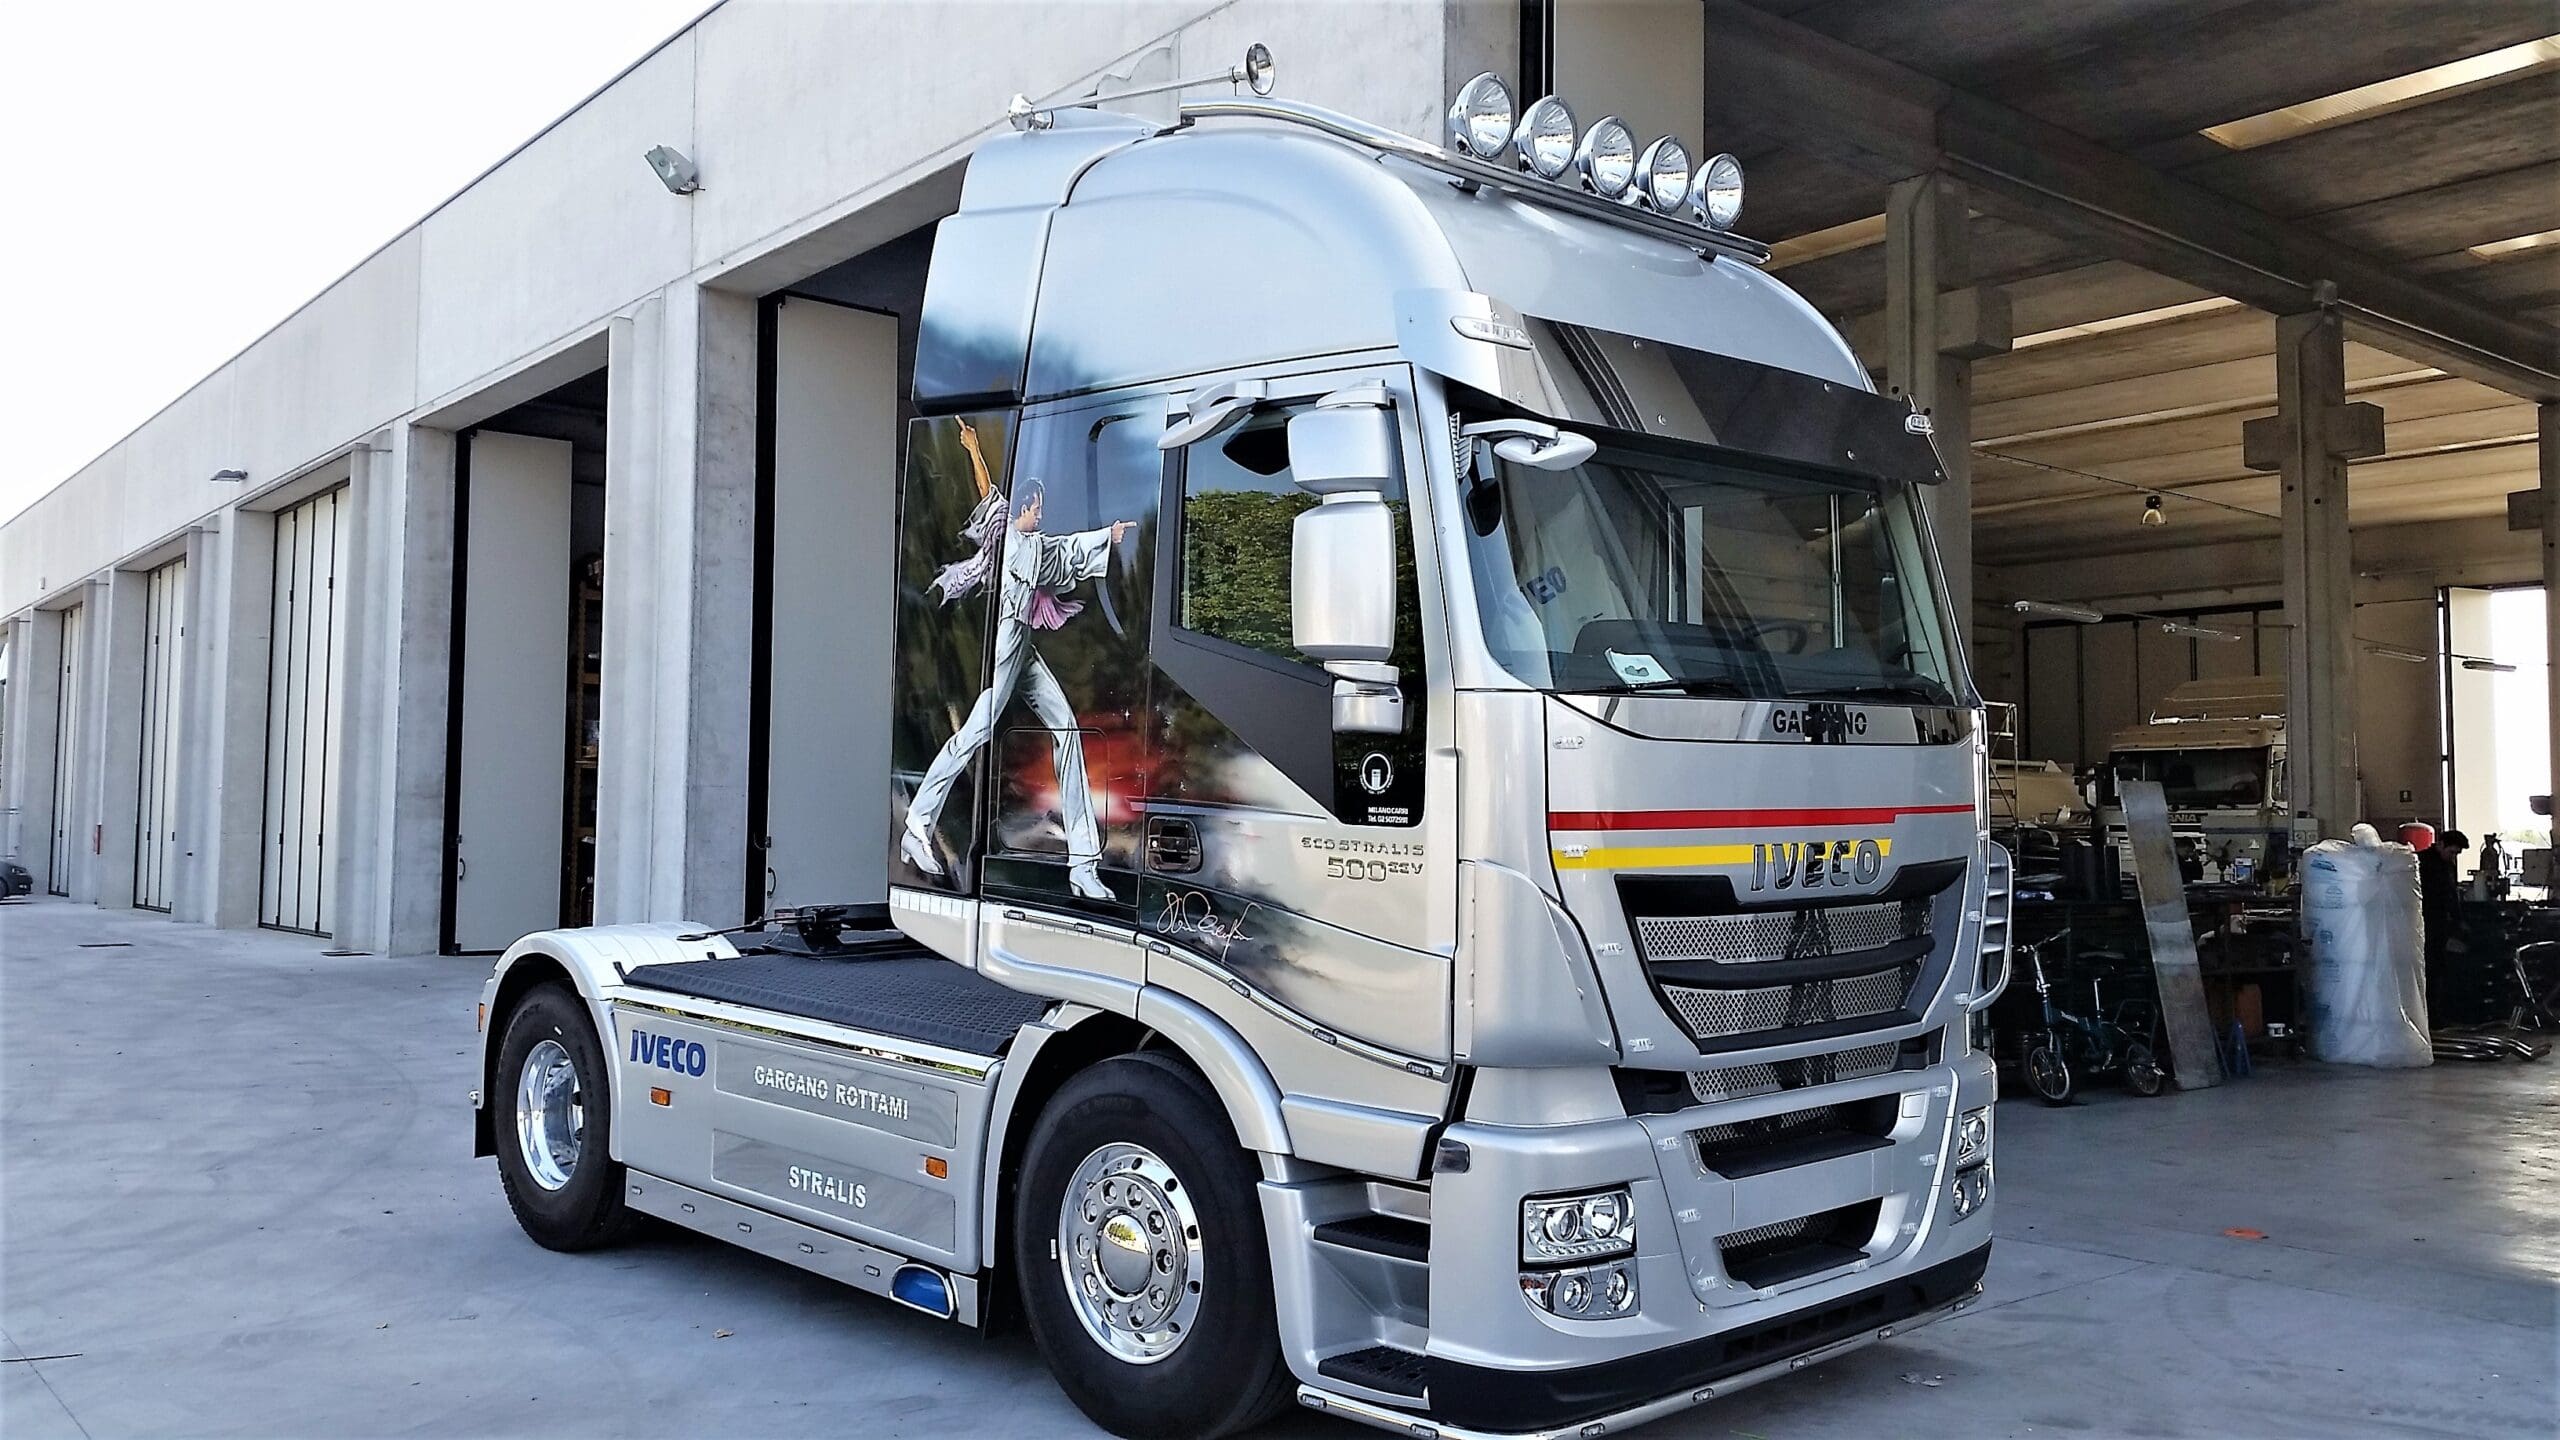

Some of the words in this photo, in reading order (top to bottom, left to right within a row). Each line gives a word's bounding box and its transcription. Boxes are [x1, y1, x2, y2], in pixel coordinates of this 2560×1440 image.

[1772, 709, 1868, 736] GARNO
[1327, 856, 1387, 882] 500
[1750, 839, 1883, 892] IVECO
[629, 1029, 707, 1078] IVECO
[753, 1065, 829, 1100] GARGANO
[834, 1083, 910, 1121] ROTTAMI
[788, 1165, 868, 1209] STRALIS
